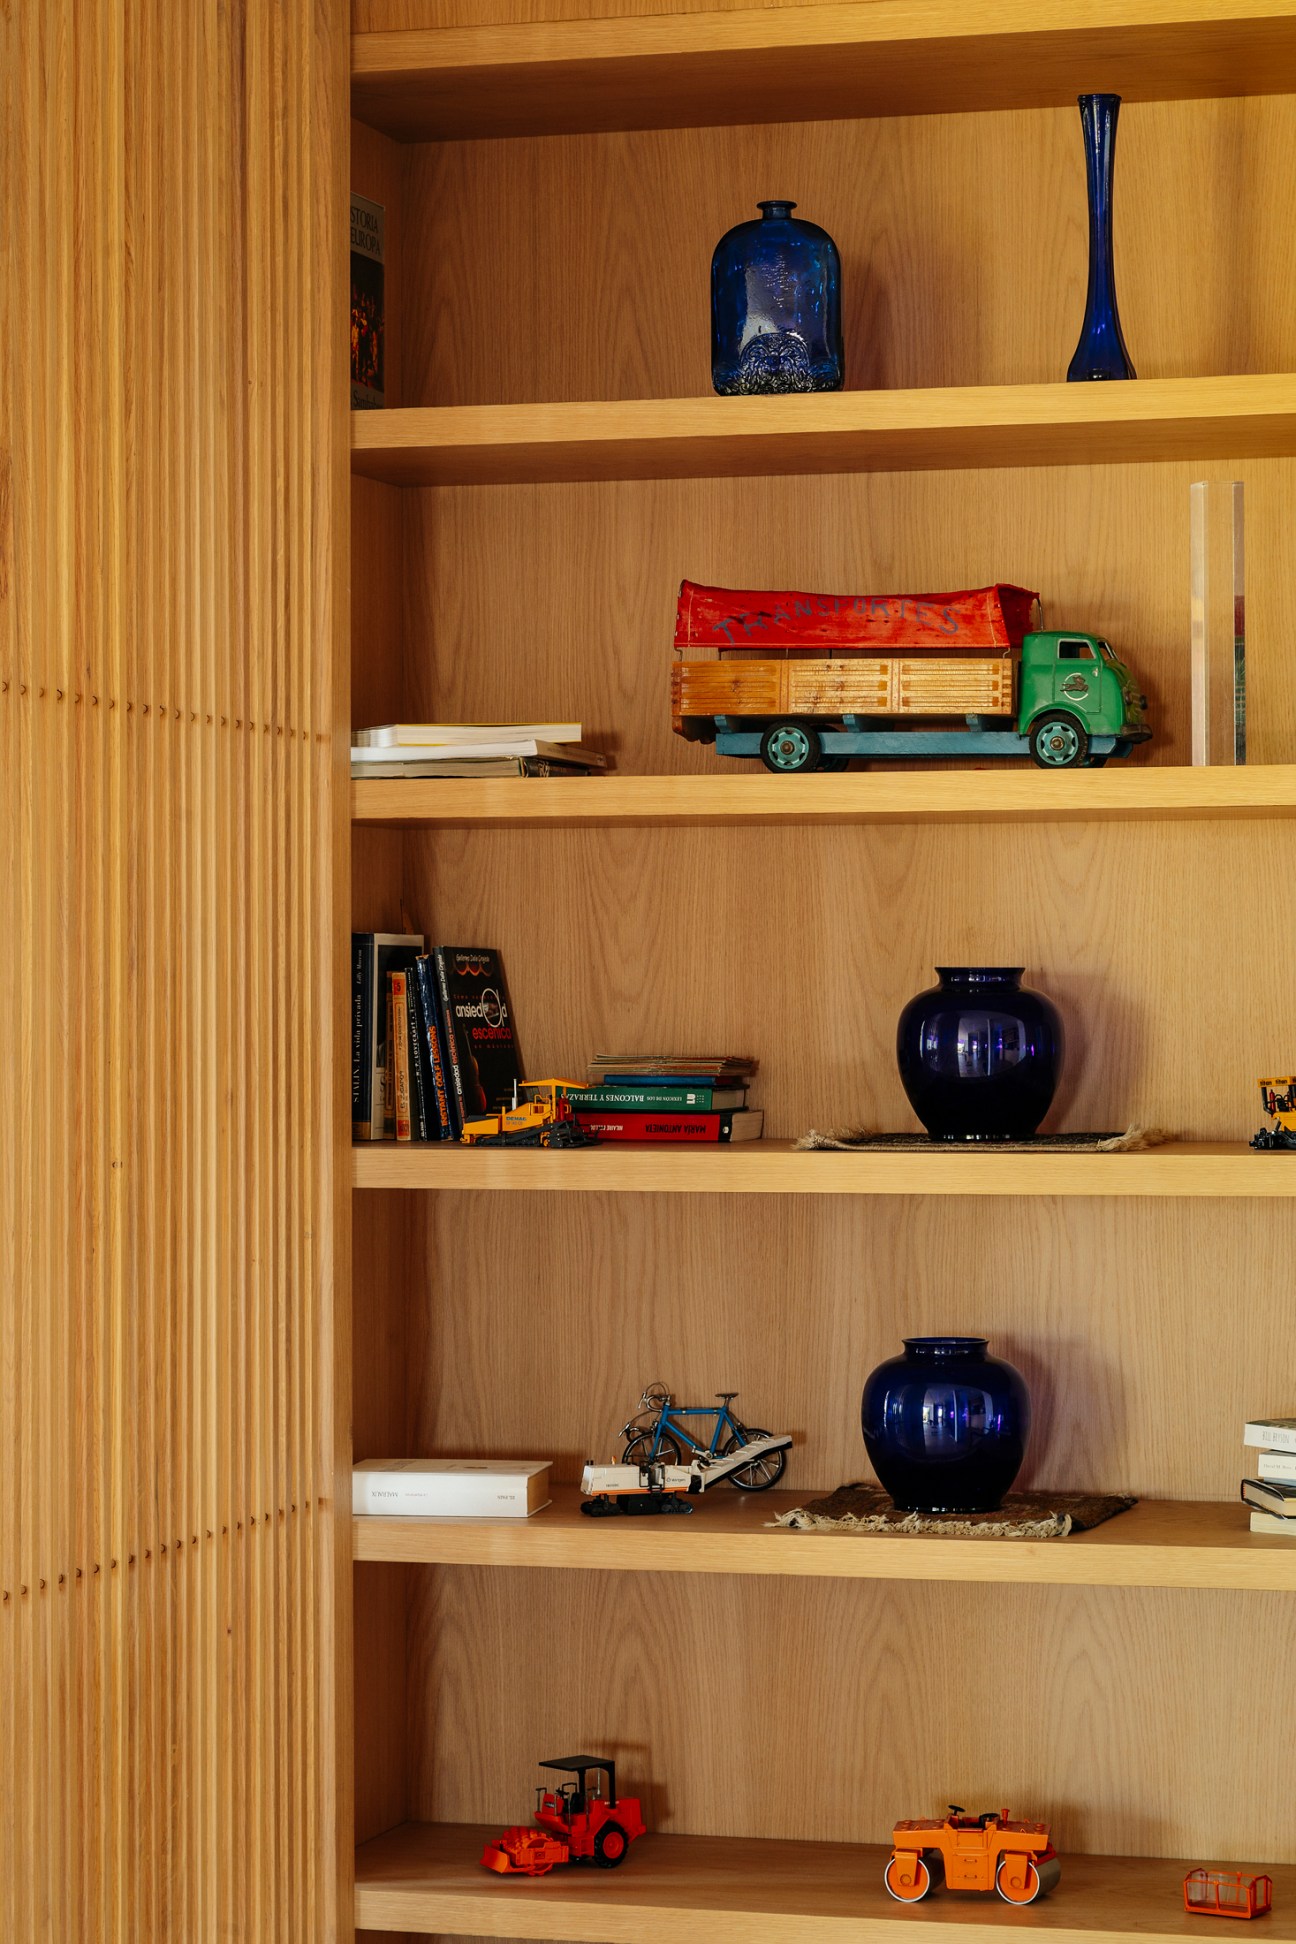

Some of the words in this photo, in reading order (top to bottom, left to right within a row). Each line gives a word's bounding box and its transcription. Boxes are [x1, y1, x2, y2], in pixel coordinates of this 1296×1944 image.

[712, 597, 961, 646] TRANSPORTES
[410, 1022, 419, 1059] LOVECRAFT
[429, 1025, 441, 1063] LESSONS
[433, 1065, 444, 1087] GOLF
[453, 1064, 462, 1095] ansiedad
[437, 1089, 449, 1126] INSTANT
[606, 1094, 644, 1102] BALCONES
[645, 1124, 682, 1134] ANTONIETA
